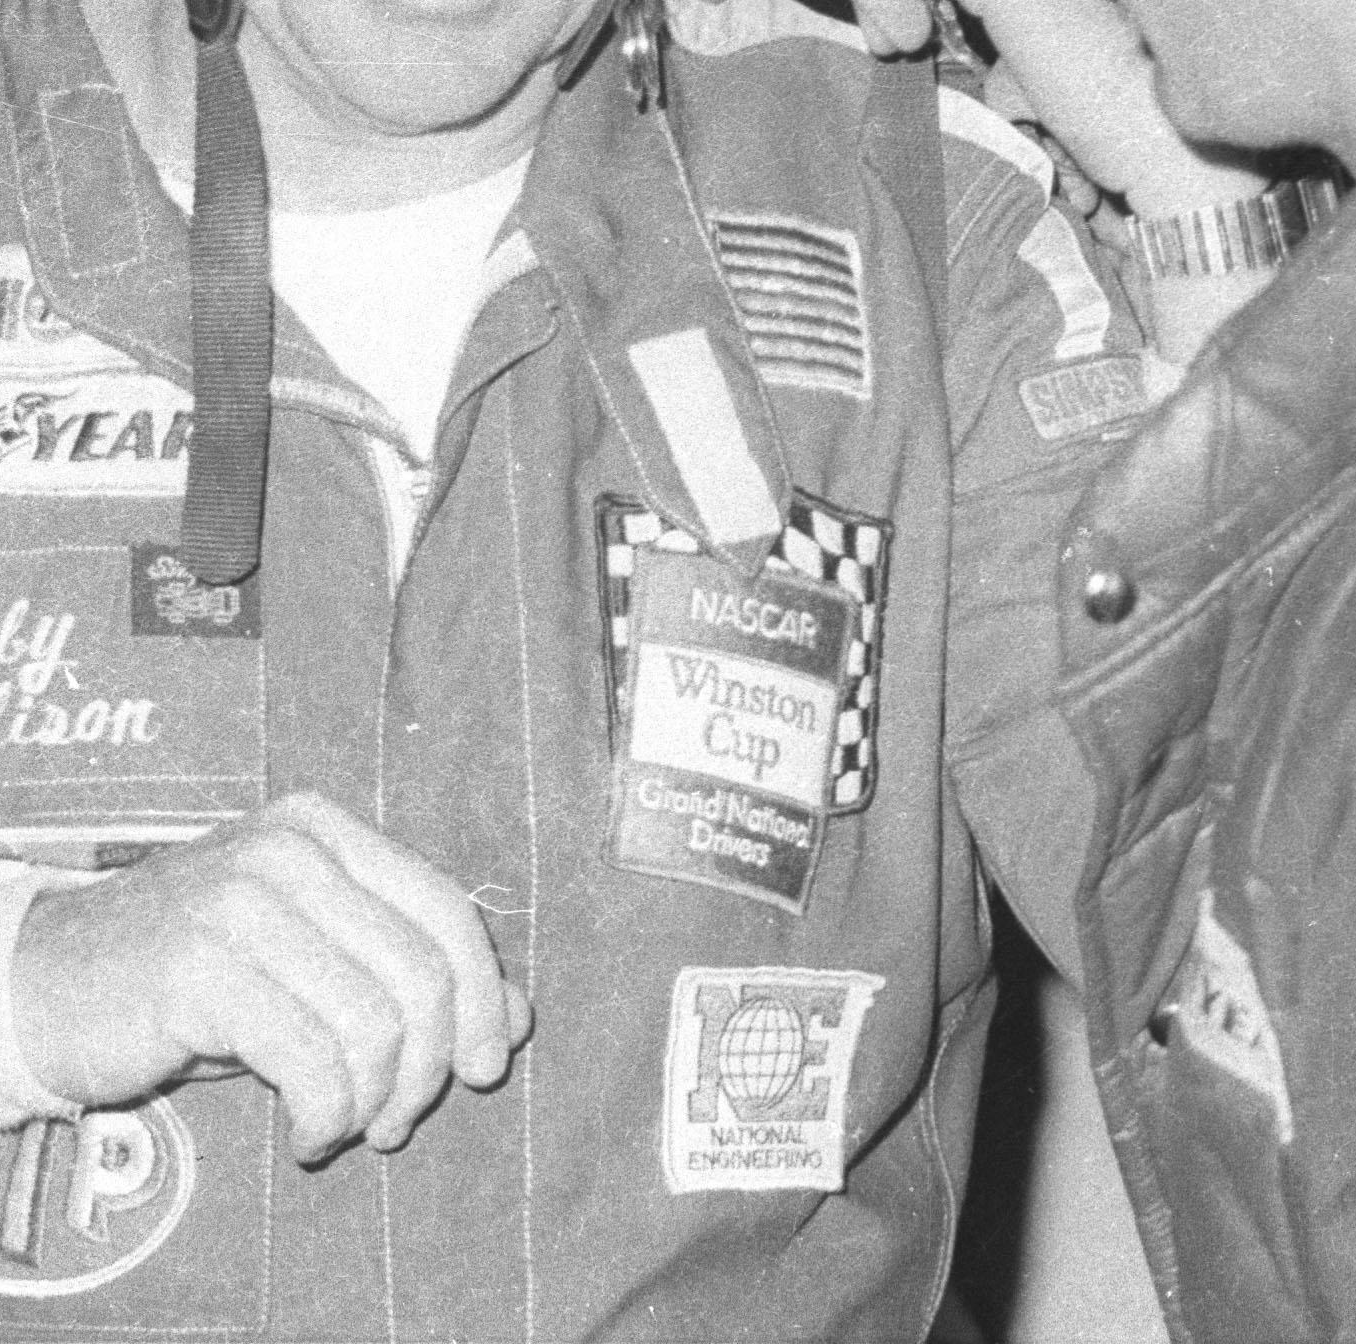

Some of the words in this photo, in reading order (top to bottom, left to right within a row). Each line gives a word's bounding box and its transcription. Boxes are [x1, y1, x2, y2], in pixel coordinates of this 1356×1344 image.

[690, 586, 819, 650] NASCAR
[669, 653, 818, 734] Winston
[700, 709, 782, 782] Cup
[637, 777, 723, 823] Grand
[686, 1147, 824, 1172] ENGINEERING
[709, 1123, 807, 1146] NATIONAL
